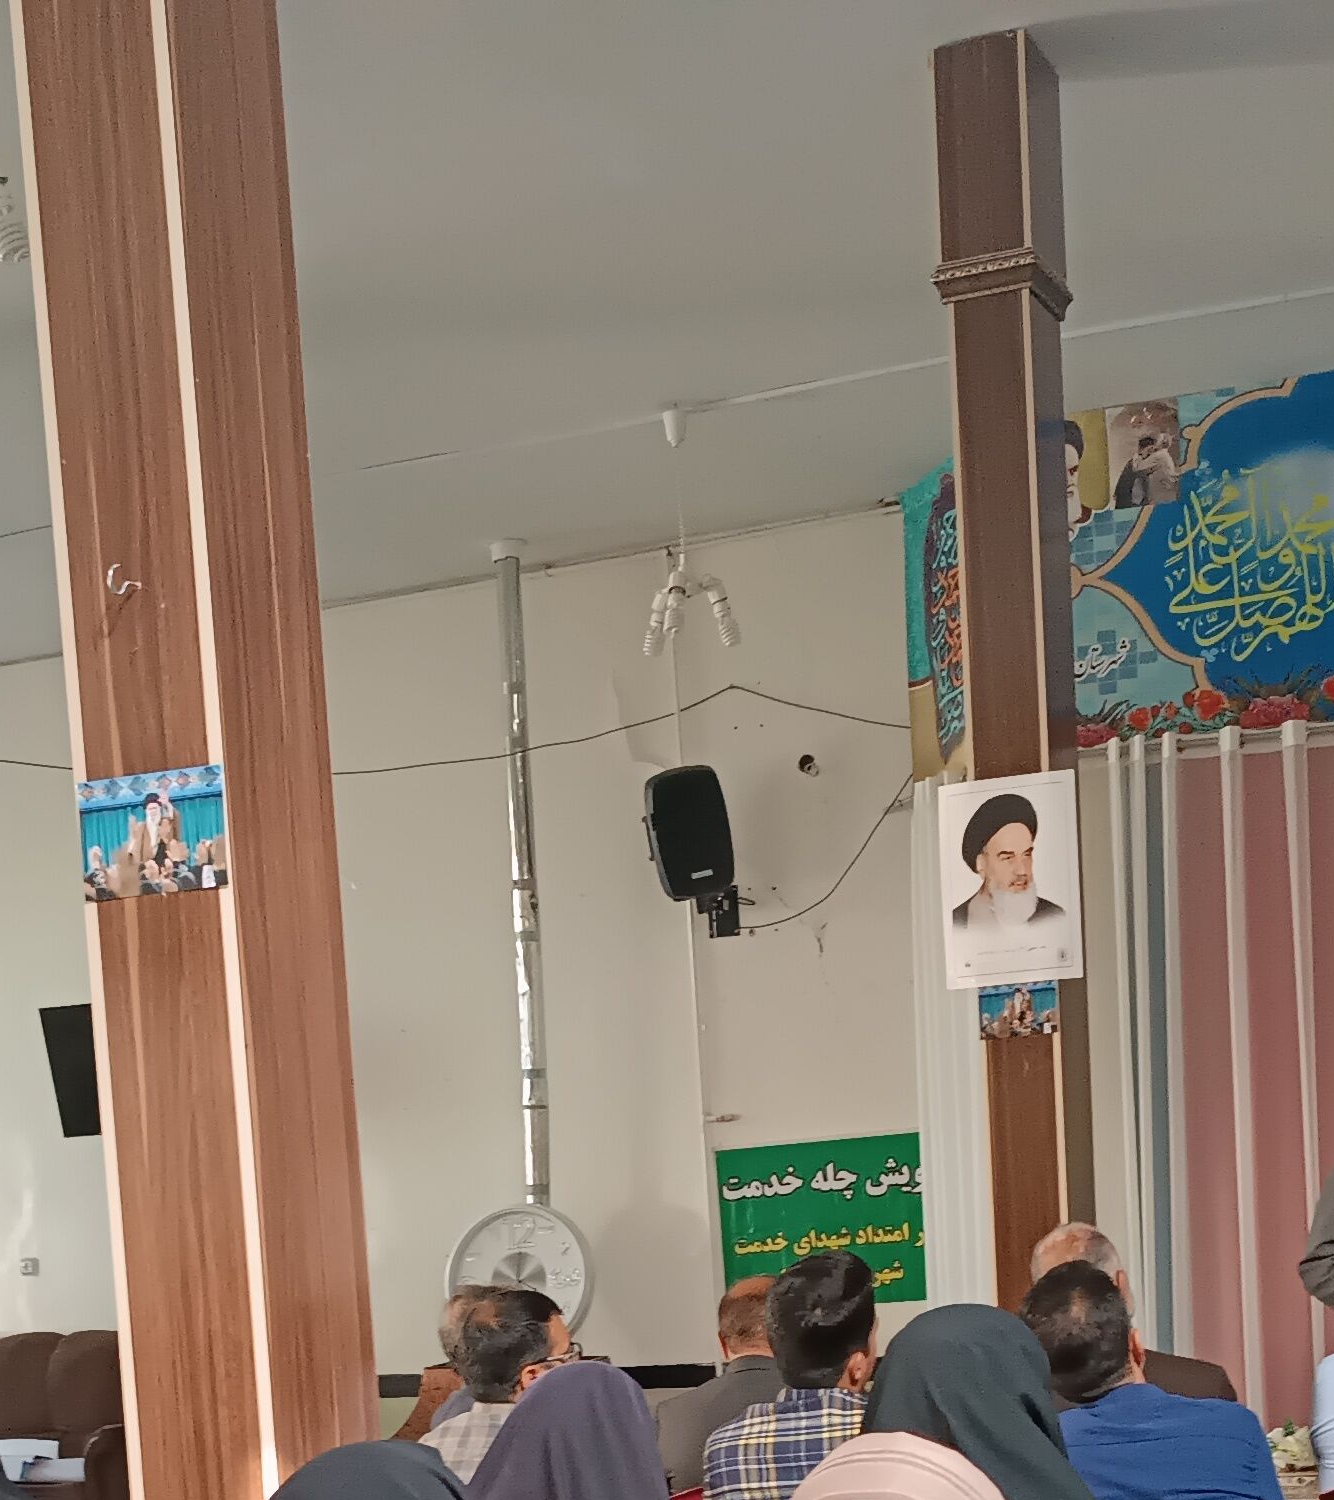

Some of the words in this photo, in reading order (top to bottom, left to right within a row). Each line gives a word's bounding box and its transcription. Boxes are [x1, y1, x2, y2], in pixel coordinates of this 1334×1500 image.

[722, 1167, 803, 1200] خدمت
[810, 1162, 858, 1199] چله
[866, 1157, 924, 1197] ویش
[734, 1232, 788, 1255] خدمت
[855, 1221, 910, 1246] امتداد
